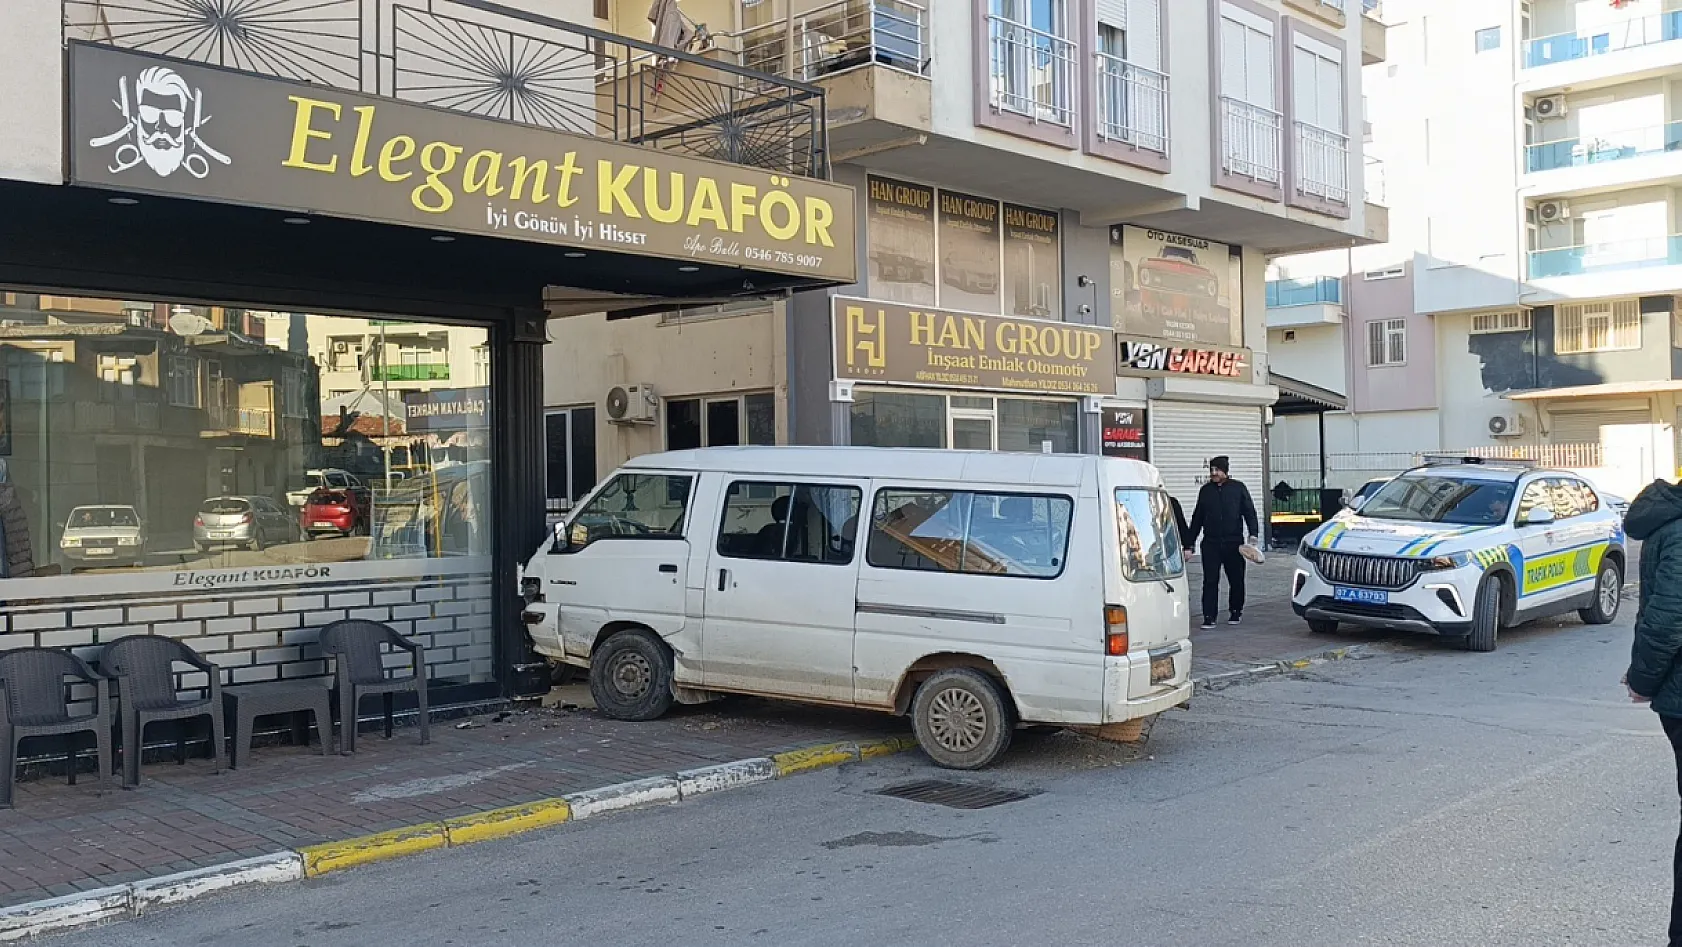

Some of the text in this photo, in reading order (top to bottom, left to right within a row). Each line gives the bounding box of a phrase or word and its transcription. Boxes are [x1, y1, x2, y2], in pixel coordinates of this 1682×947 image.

[282, 95, 835, 248] Elegant KUAFÖR
[870, 180, 931, 210] HAN GROUP
[941, 195, 996, 221] HAN GROUP
[487, 202, 508, 230] İyi
[574, 214, 594, 242] İyi
[1005, 208, 1056, 233] HAN GROUP
[1147, 230, 1209, 250] OTO AKSESUAR
[745, 246, 772, 262] 0546
[774, 250, 794, 264] 785
[796, 254, 823, 268] 9007
[909, 311, 1101, 360] HAN GROUP
[928, 348, 1088, 377] İnşaat Emlak Otomotiv
[1168, 347, 1245, 377] GARAGE
[1103, 427, 1144, 440] GARAGE
[173, 564, 330, 588] Elegant KUAFÖR
[1336, 588, 1347, 597] 07
[1349, 589, 1356, 599] A
